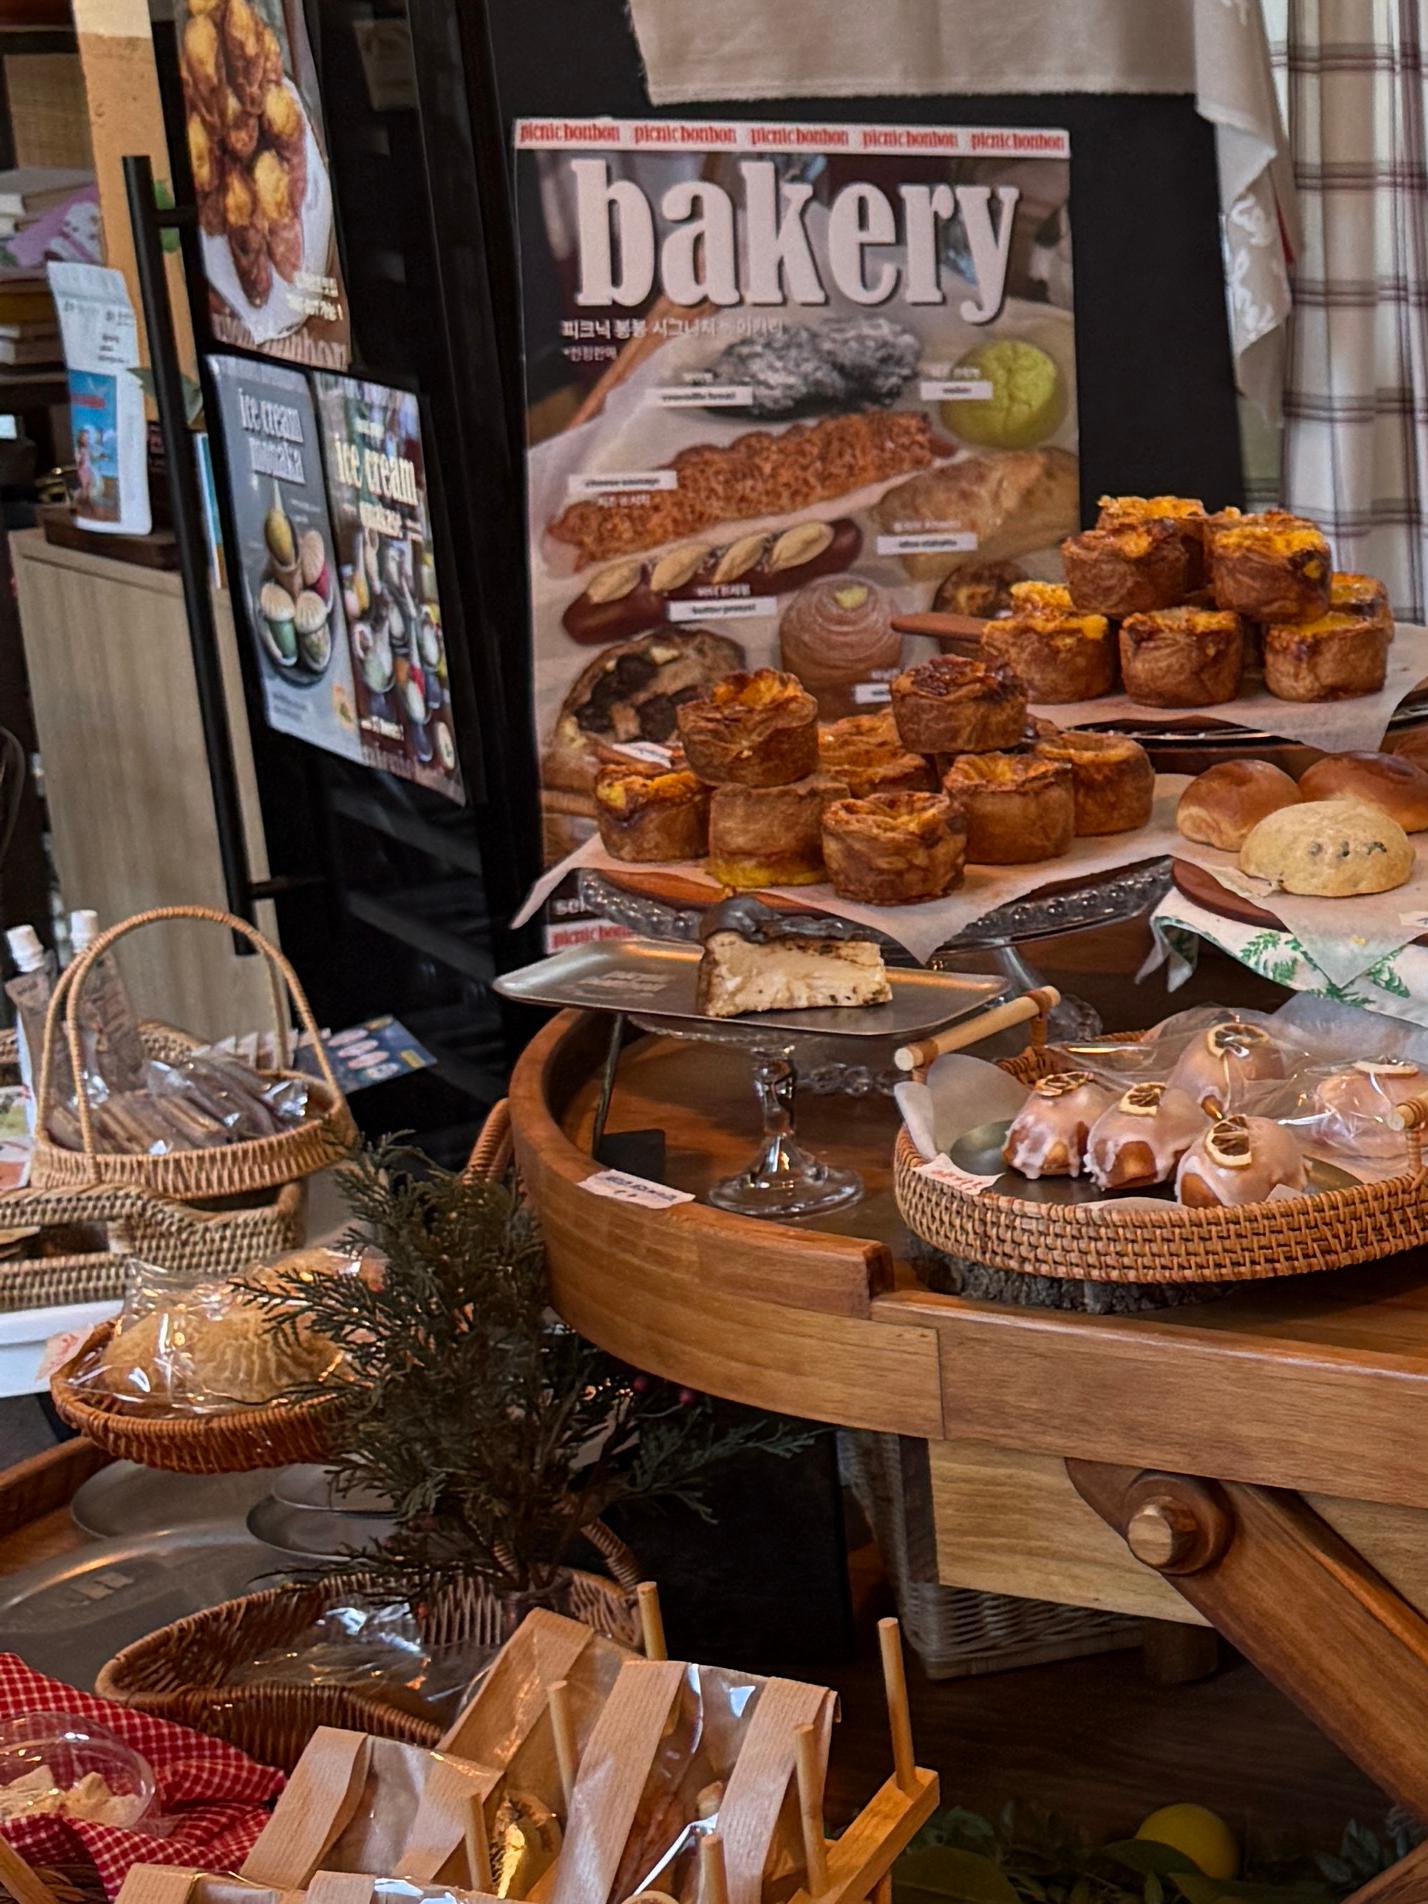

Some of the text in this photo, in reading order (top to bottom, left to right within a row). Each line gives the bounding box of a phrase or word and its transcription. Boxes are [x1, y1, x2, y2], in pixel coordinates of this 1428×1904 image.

[520, 124, 1064, 150] picnic bonbon picnic bonbon picnic bonbon picnic bonbon picnic bonbon
[570, 158, 1020, 324] bakery
[560, 318, 611, 340] 피크닉
[614, 318, 646, 340] 봉봉
[334, 432, 418, 506] ice cream
